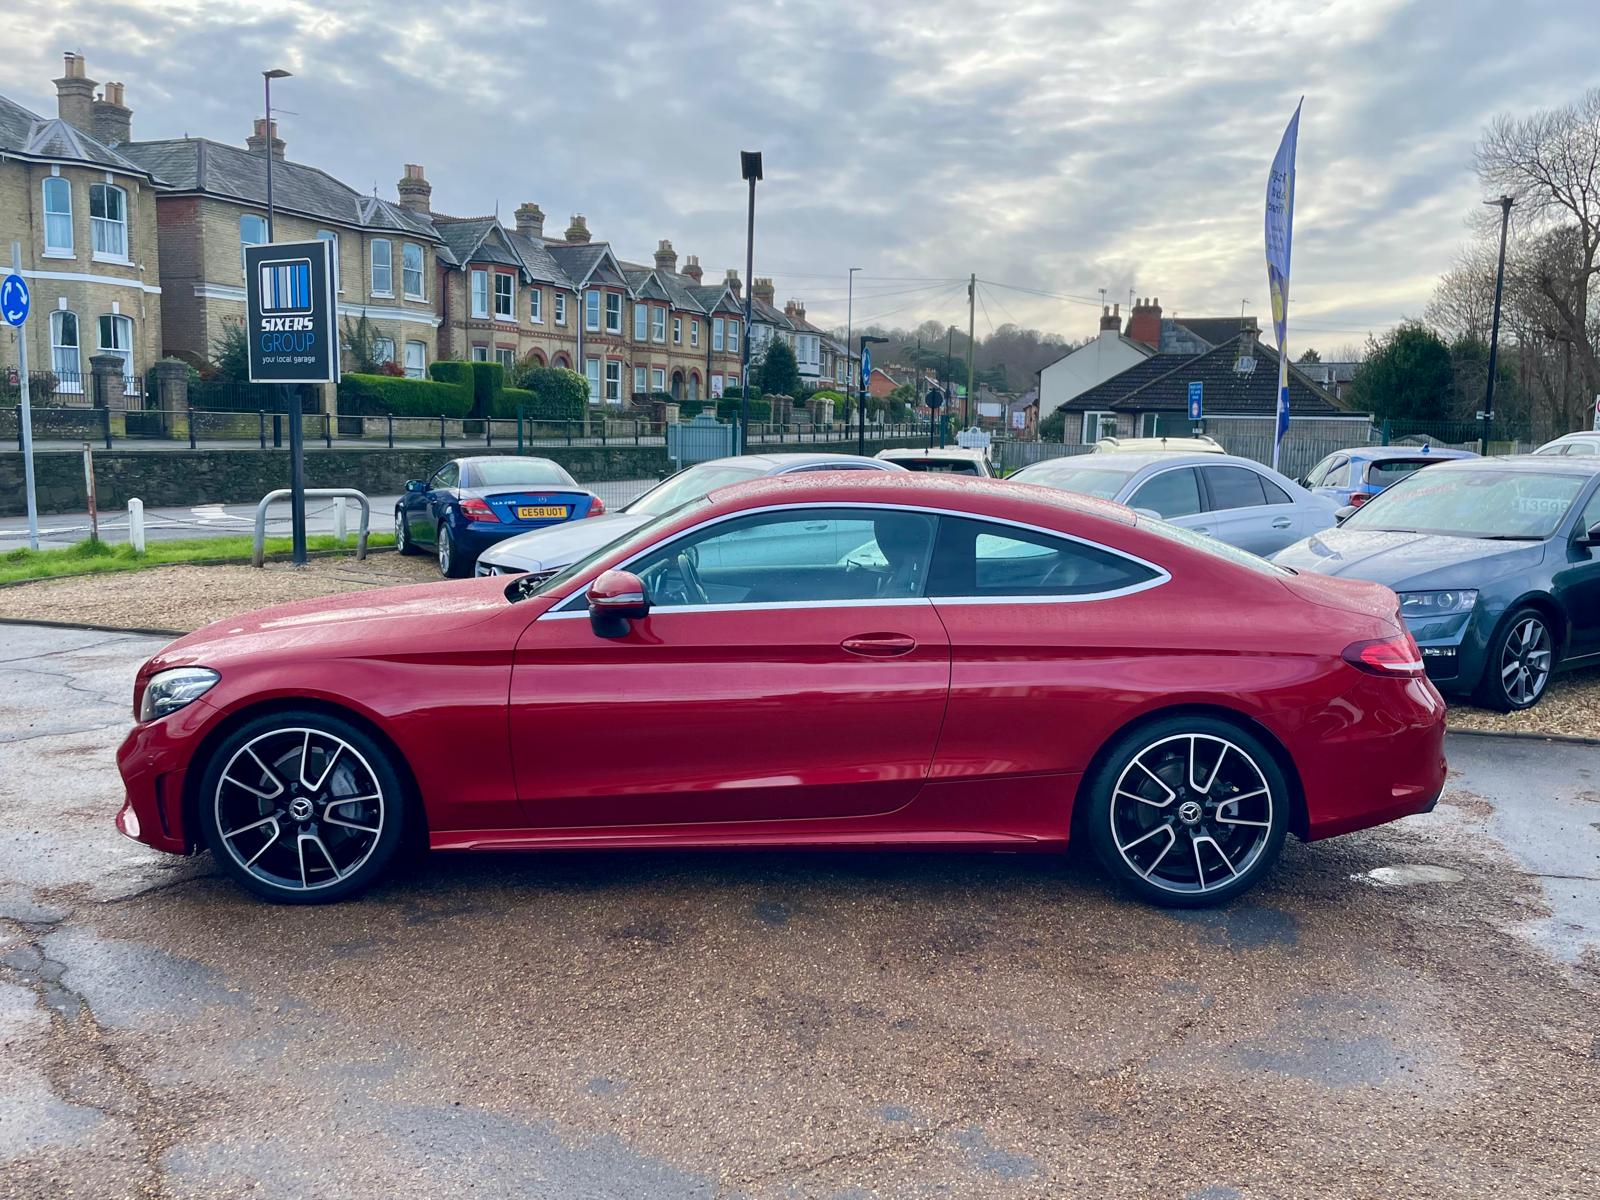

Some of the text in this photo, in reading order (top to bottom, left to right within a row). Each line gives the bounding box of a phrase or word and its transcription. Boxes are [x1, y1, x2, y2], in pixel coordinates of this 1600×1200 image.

[261, 317, 313, 331] SIXERS
[261, 333, 315, 352] GROUP
[262, 355, 316, 365] your local garage
[521, 508, 563, 517] CE58 UOT
